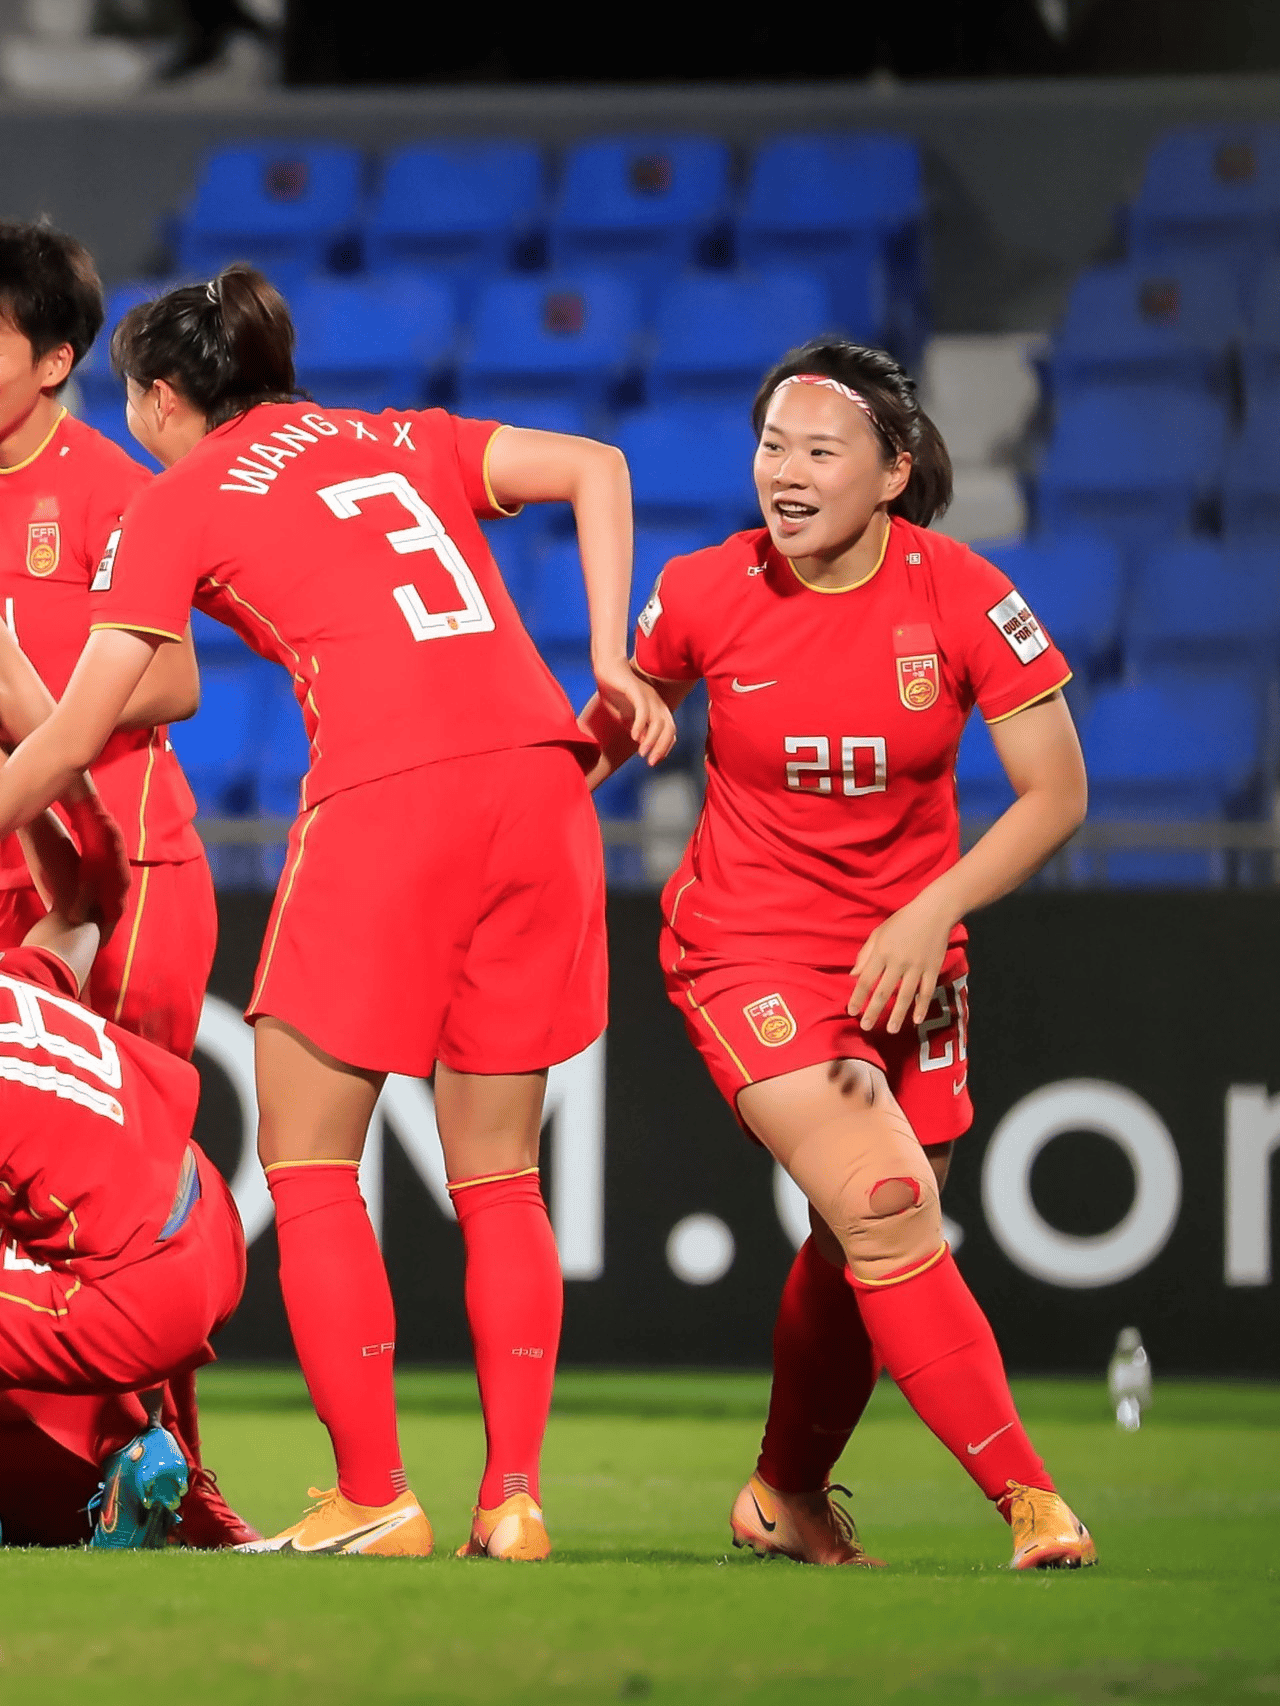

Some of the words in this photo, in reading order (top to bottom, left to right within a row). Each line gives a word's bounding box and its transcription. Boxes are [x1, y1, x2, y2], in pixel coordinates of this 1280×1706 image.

[219, 413, 339, 495] WANG
[31, 527, 56, 539] CFA
[316, 472, 496, 642] 3
[1003, 617, 1022, 635] OUR
[1014, 625, 1033, 645] FOR
[902, 659, 935, 673] CFA
[784, 735, 888, 797] 20
[749, 998, 781, 1017] CFA
